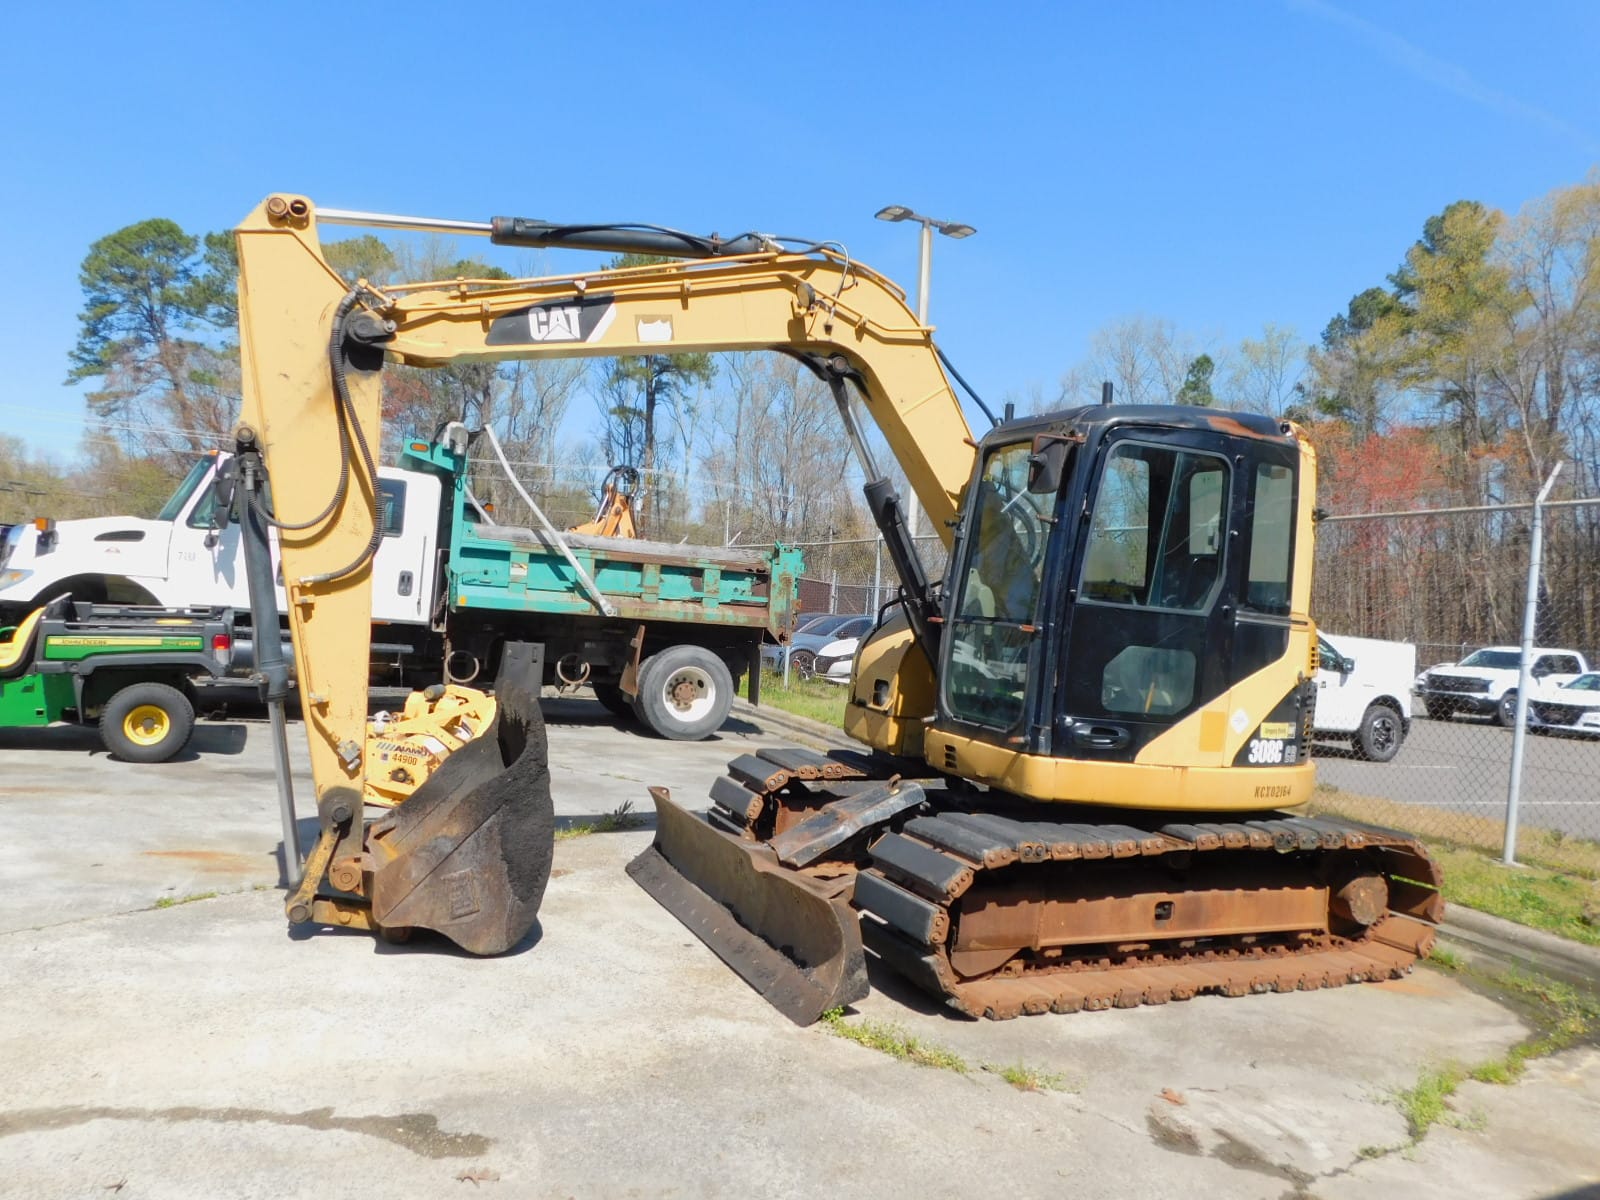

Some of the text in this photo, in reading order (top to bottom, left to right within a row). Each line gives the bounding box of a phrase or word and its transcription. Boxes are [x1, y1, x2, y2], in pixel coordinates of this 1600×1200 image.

[528, 306, 582, 341] CAT
[392, 753, 417, 766] 44900
[1248, 739, 1284, 763] 308C
